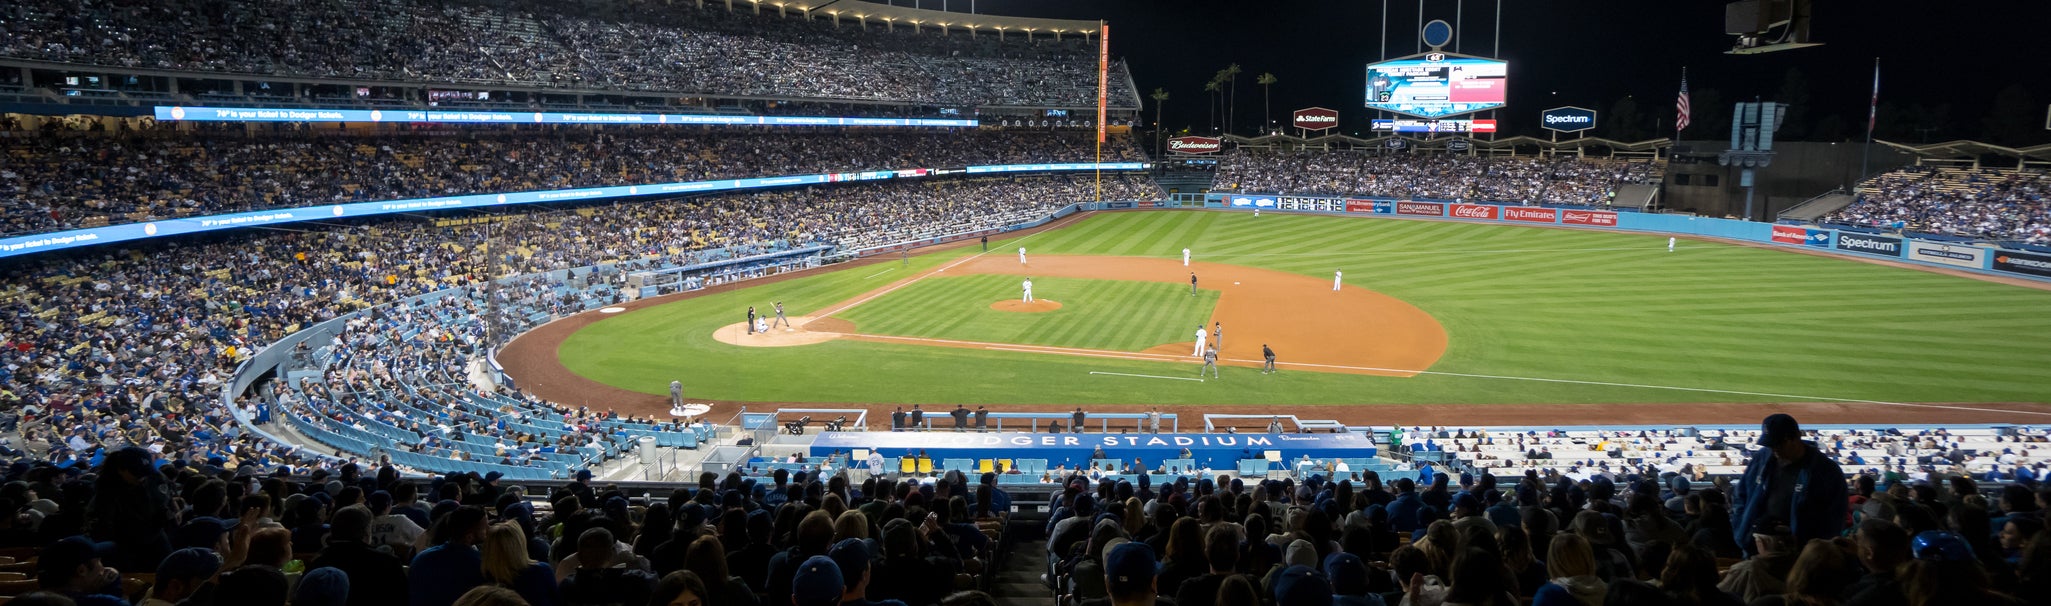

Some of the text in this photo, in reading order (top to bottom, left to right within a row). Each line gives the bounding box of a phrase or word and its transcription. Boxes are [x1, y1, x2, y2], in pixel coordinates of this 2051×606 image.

[289, 111, 317, 120] Dodger
[1546, 115, 1588, 124] Spectrum
[1170, 140, 1218, 149] Budweiser
[1506, 209, 1518, 218] Fly
[1520, 210, 1555, 219] Emirates
[10, 243, 25, 251] your
[25, 239, 43, 248] ticket
[1841, 236, 1894, 251] Spectrum
[928, 436, 1272, 446] ODGER STADIUM
